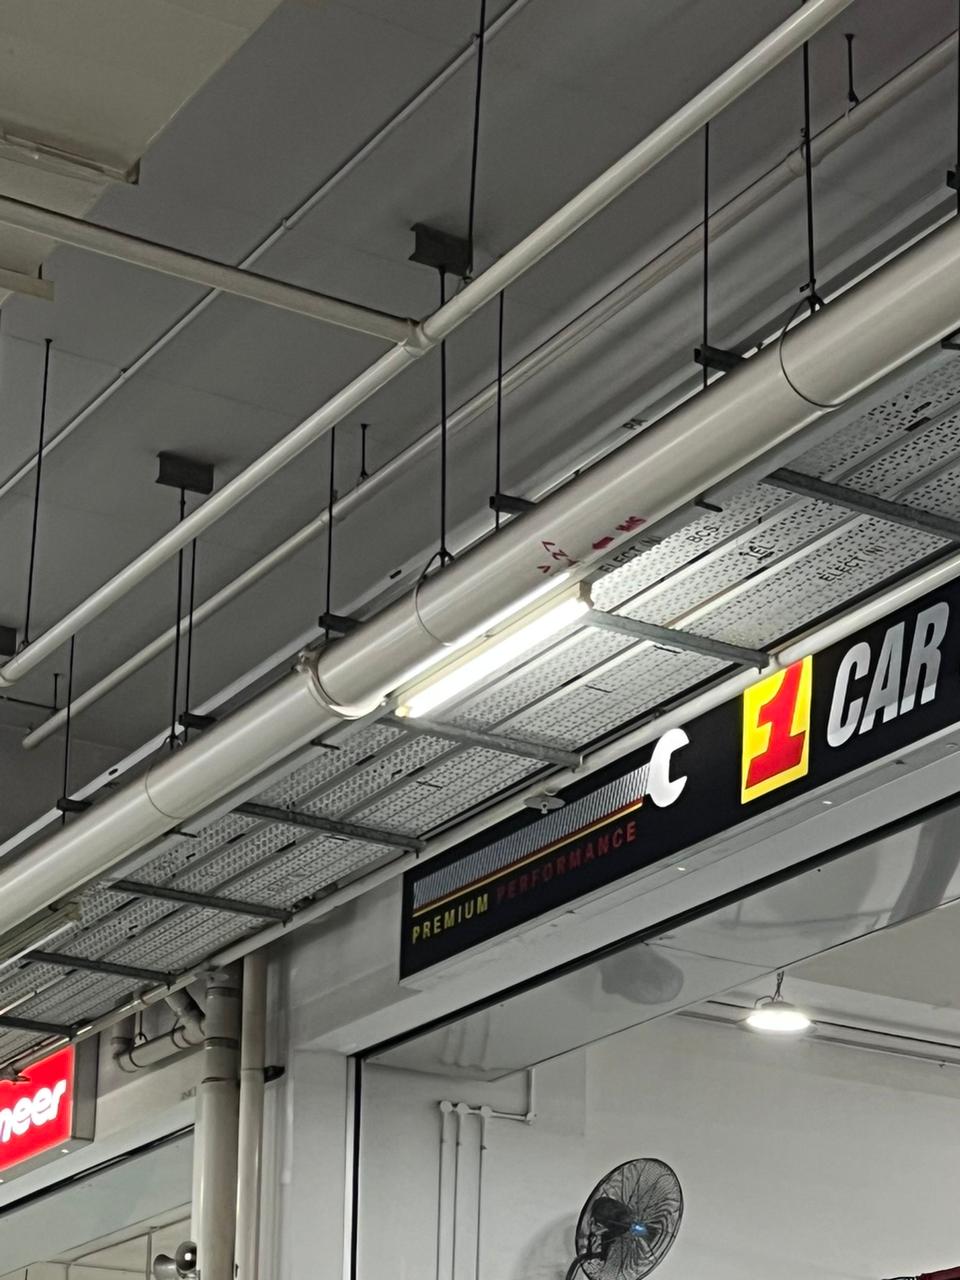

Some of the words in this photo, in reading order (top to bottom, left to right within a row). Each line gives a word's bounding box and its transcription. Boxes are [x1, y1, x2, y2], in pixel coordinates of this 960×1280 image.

[687, 524, 720, 544] BCS
[818, 556, 866, 582] ELECT
[745, 660, 807, 789] 1
[828, 602, 950, 748] CAR
[412, 893, 489, 944] PREMIUM
[496, 820, 637, 904] PERFORMANCE
